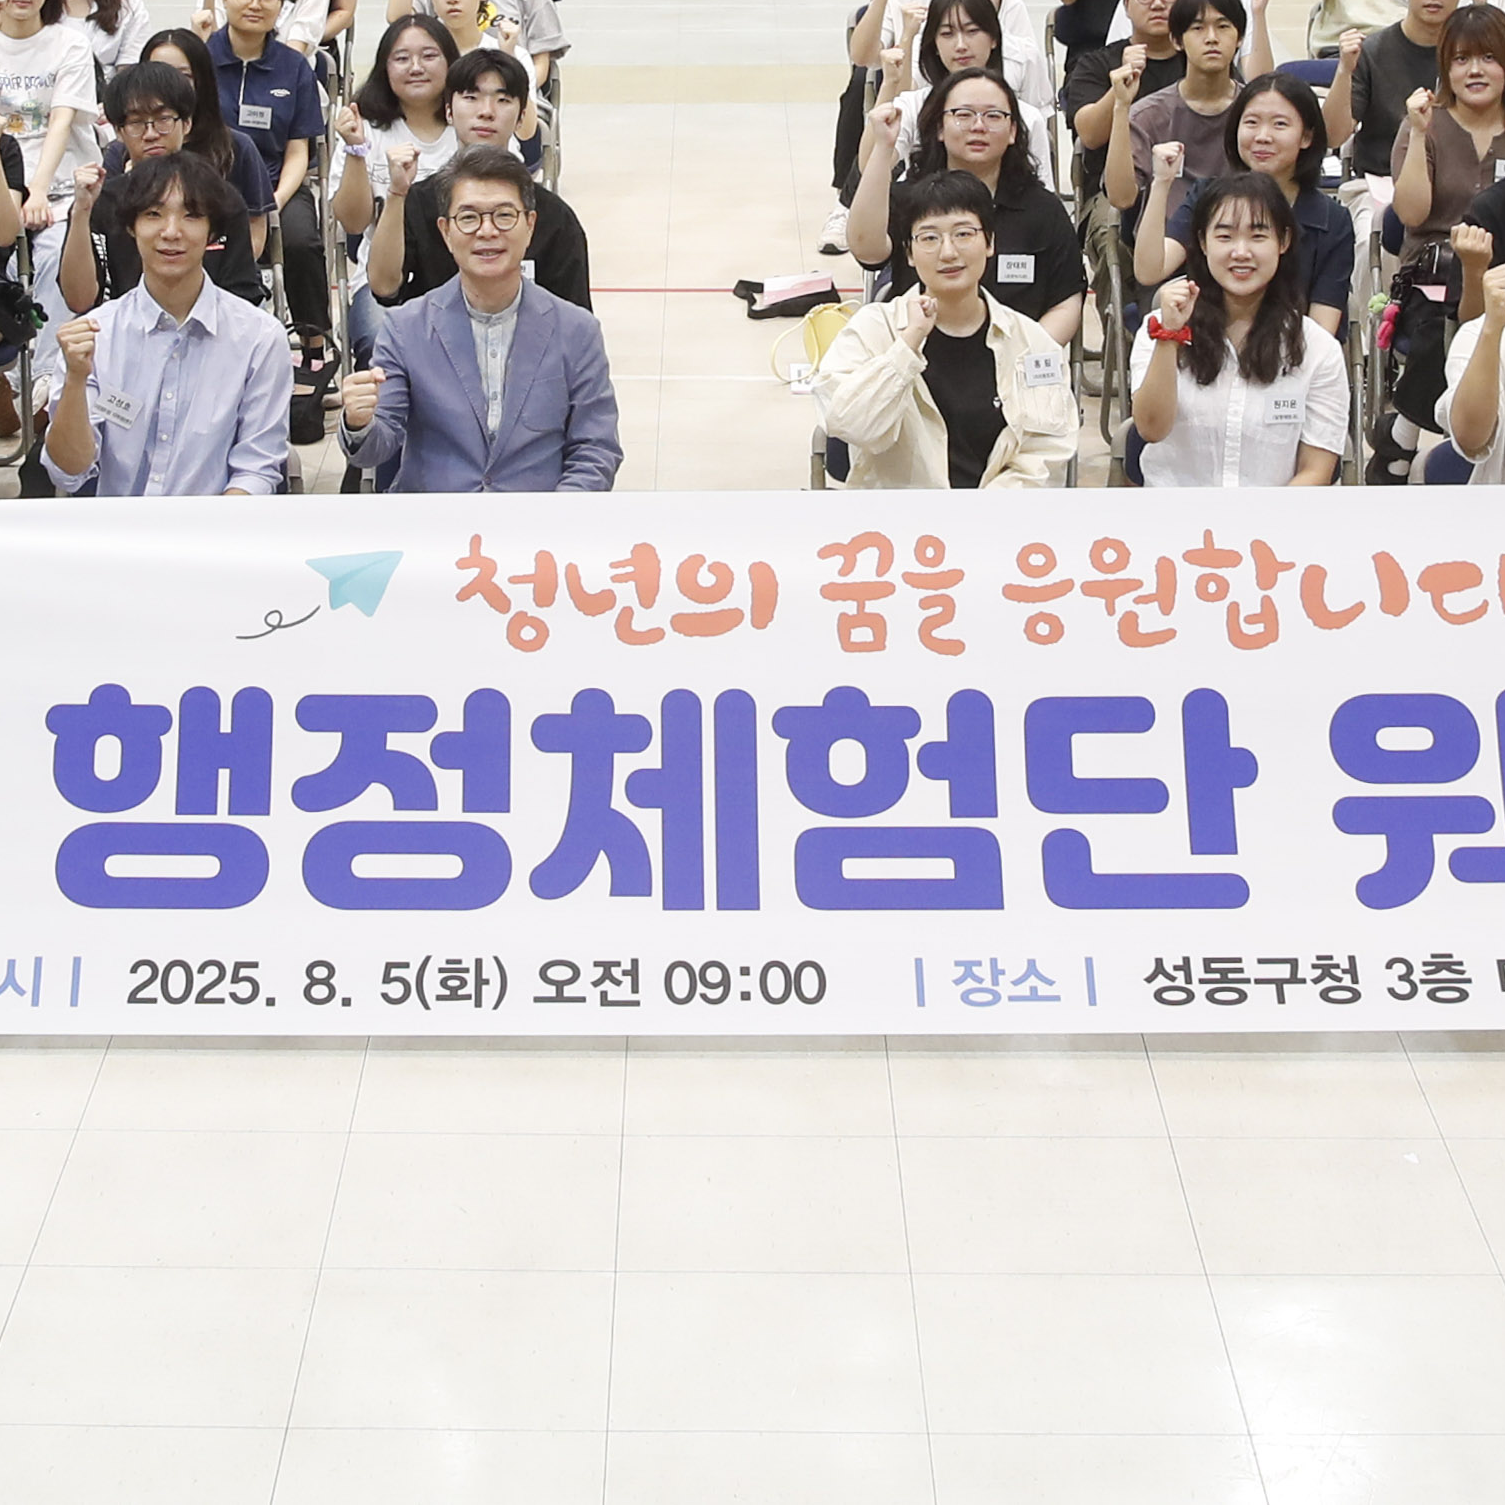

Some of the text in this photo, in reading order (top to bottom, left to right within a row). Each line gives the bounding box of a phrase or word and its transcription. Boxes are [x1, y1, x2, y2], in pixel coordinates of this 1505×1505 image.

[455, 534, 779, 653] 청년의
[817, 531, 965, 655] 꿈을
[45, 685, 1259, 911] 행정체험단
[127, 959, 277, 1008] 2025.
[303, 959, 352, 1007] 8.
[380, 955, 509, 1011] 5(화)
[532, 956, 643, 1008] 오전
[664, 960, 827, 1006] 09:00
[951, 957, 1063, 1007] 장소
[1143, 954, 1362, 1007] 성동구청
[1384, 954, 1473, 1005] 3층
